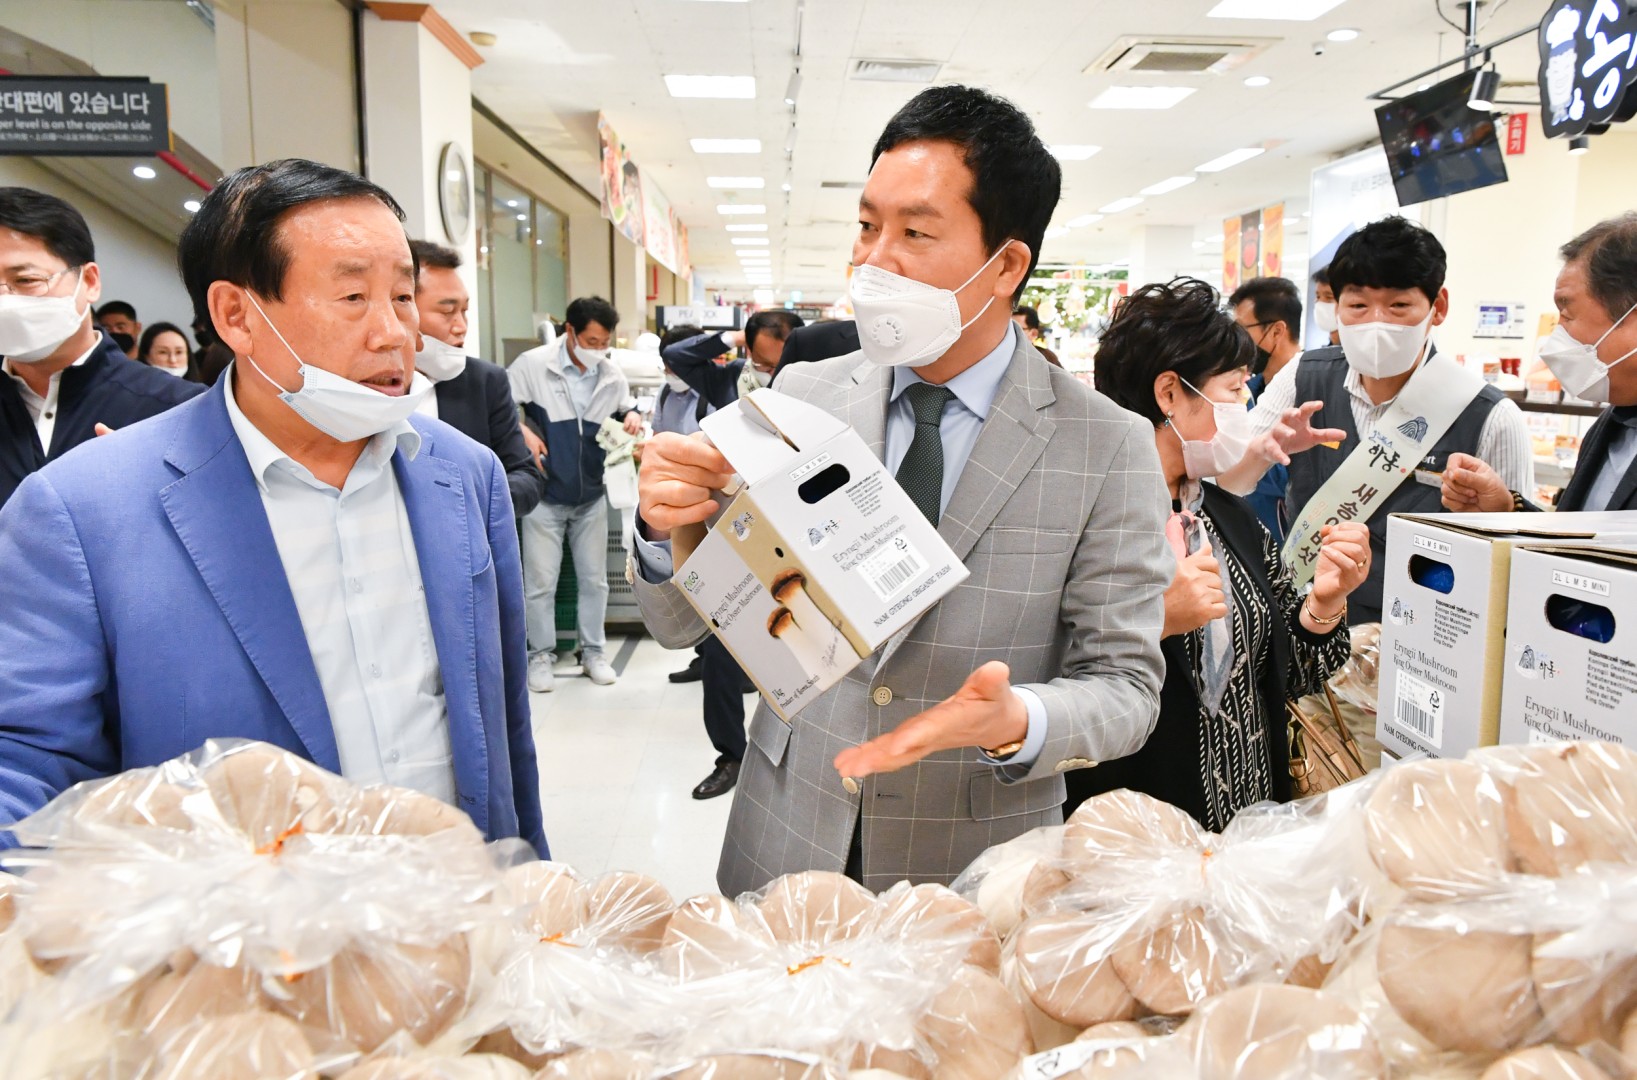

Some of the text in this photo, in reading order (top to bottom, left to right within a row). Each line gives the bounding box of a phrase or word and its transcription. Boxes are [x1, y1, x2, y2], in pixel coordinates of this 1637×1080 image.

[1582, 0, 1637, 109] 송
[0, 91, 150, 115] 대편에 있습니다
[15, 118, 39, 129] level
[41, 119, 50, 129] is
[52, 121, 65, 130] on
[67, 120, 83, 130] the
[85, 120, 129, 131] opposite
[131, 120, 151, 131] side
[1368, 444, 1400, 472] 하동
[832, 539, 862, 562] Eryngii
[860, 515, 899, 541] Mushroom
[1298, 483, 1379, 566] 새송버섯
[840, 558, 858, 572] King
[856, 545, 876, 560] Oyster
[874, 524, 906, 545] Mushroom
[1414, 537, 1420, 545] 2L
[1439, 544, 1449, 552] MINI
[710, 573, 755, 619] Eryngii Mushroom
[873, 612, 890, 627] NAM
[889, 595, 913, 615] GYEONG
[911, 576, 936, 597] ORGANIC
[935, 564, 952, 579] FARM
[1554, 573, 1562, 582] 2L
[1573, 577, 1579, 585] M
[1583, 580, 1587, 588] S
[1591, 582, 1607, 593] MINI
[726, 606, 742, 621] Oyster
[738, 583, 763, 608] Mushroom
[1450, 617, 1471, 629] Mushroom
[1394, 639, 1458, 678] Eryngii Mushroom
[1539, 660, 1556, 680] 하동
[1587, 664, 1608, 675] Eryngii
[1393, 653, 1405, 671] King
[1405, 660, 1423, 676] Oyster
[1424, 669, 1457, 693] Mushroom
[1585, 695, 1615, 710] King Oyster
[1524, 713, 1541, 732] King
[1543, 722, 1570, 741] Oyster
[1525, 695, 1622, 744] Eryngii Mushroom
[1384, 722, 1395, 736] NAM
[1395, 730, 1417, 750] GYEONG
